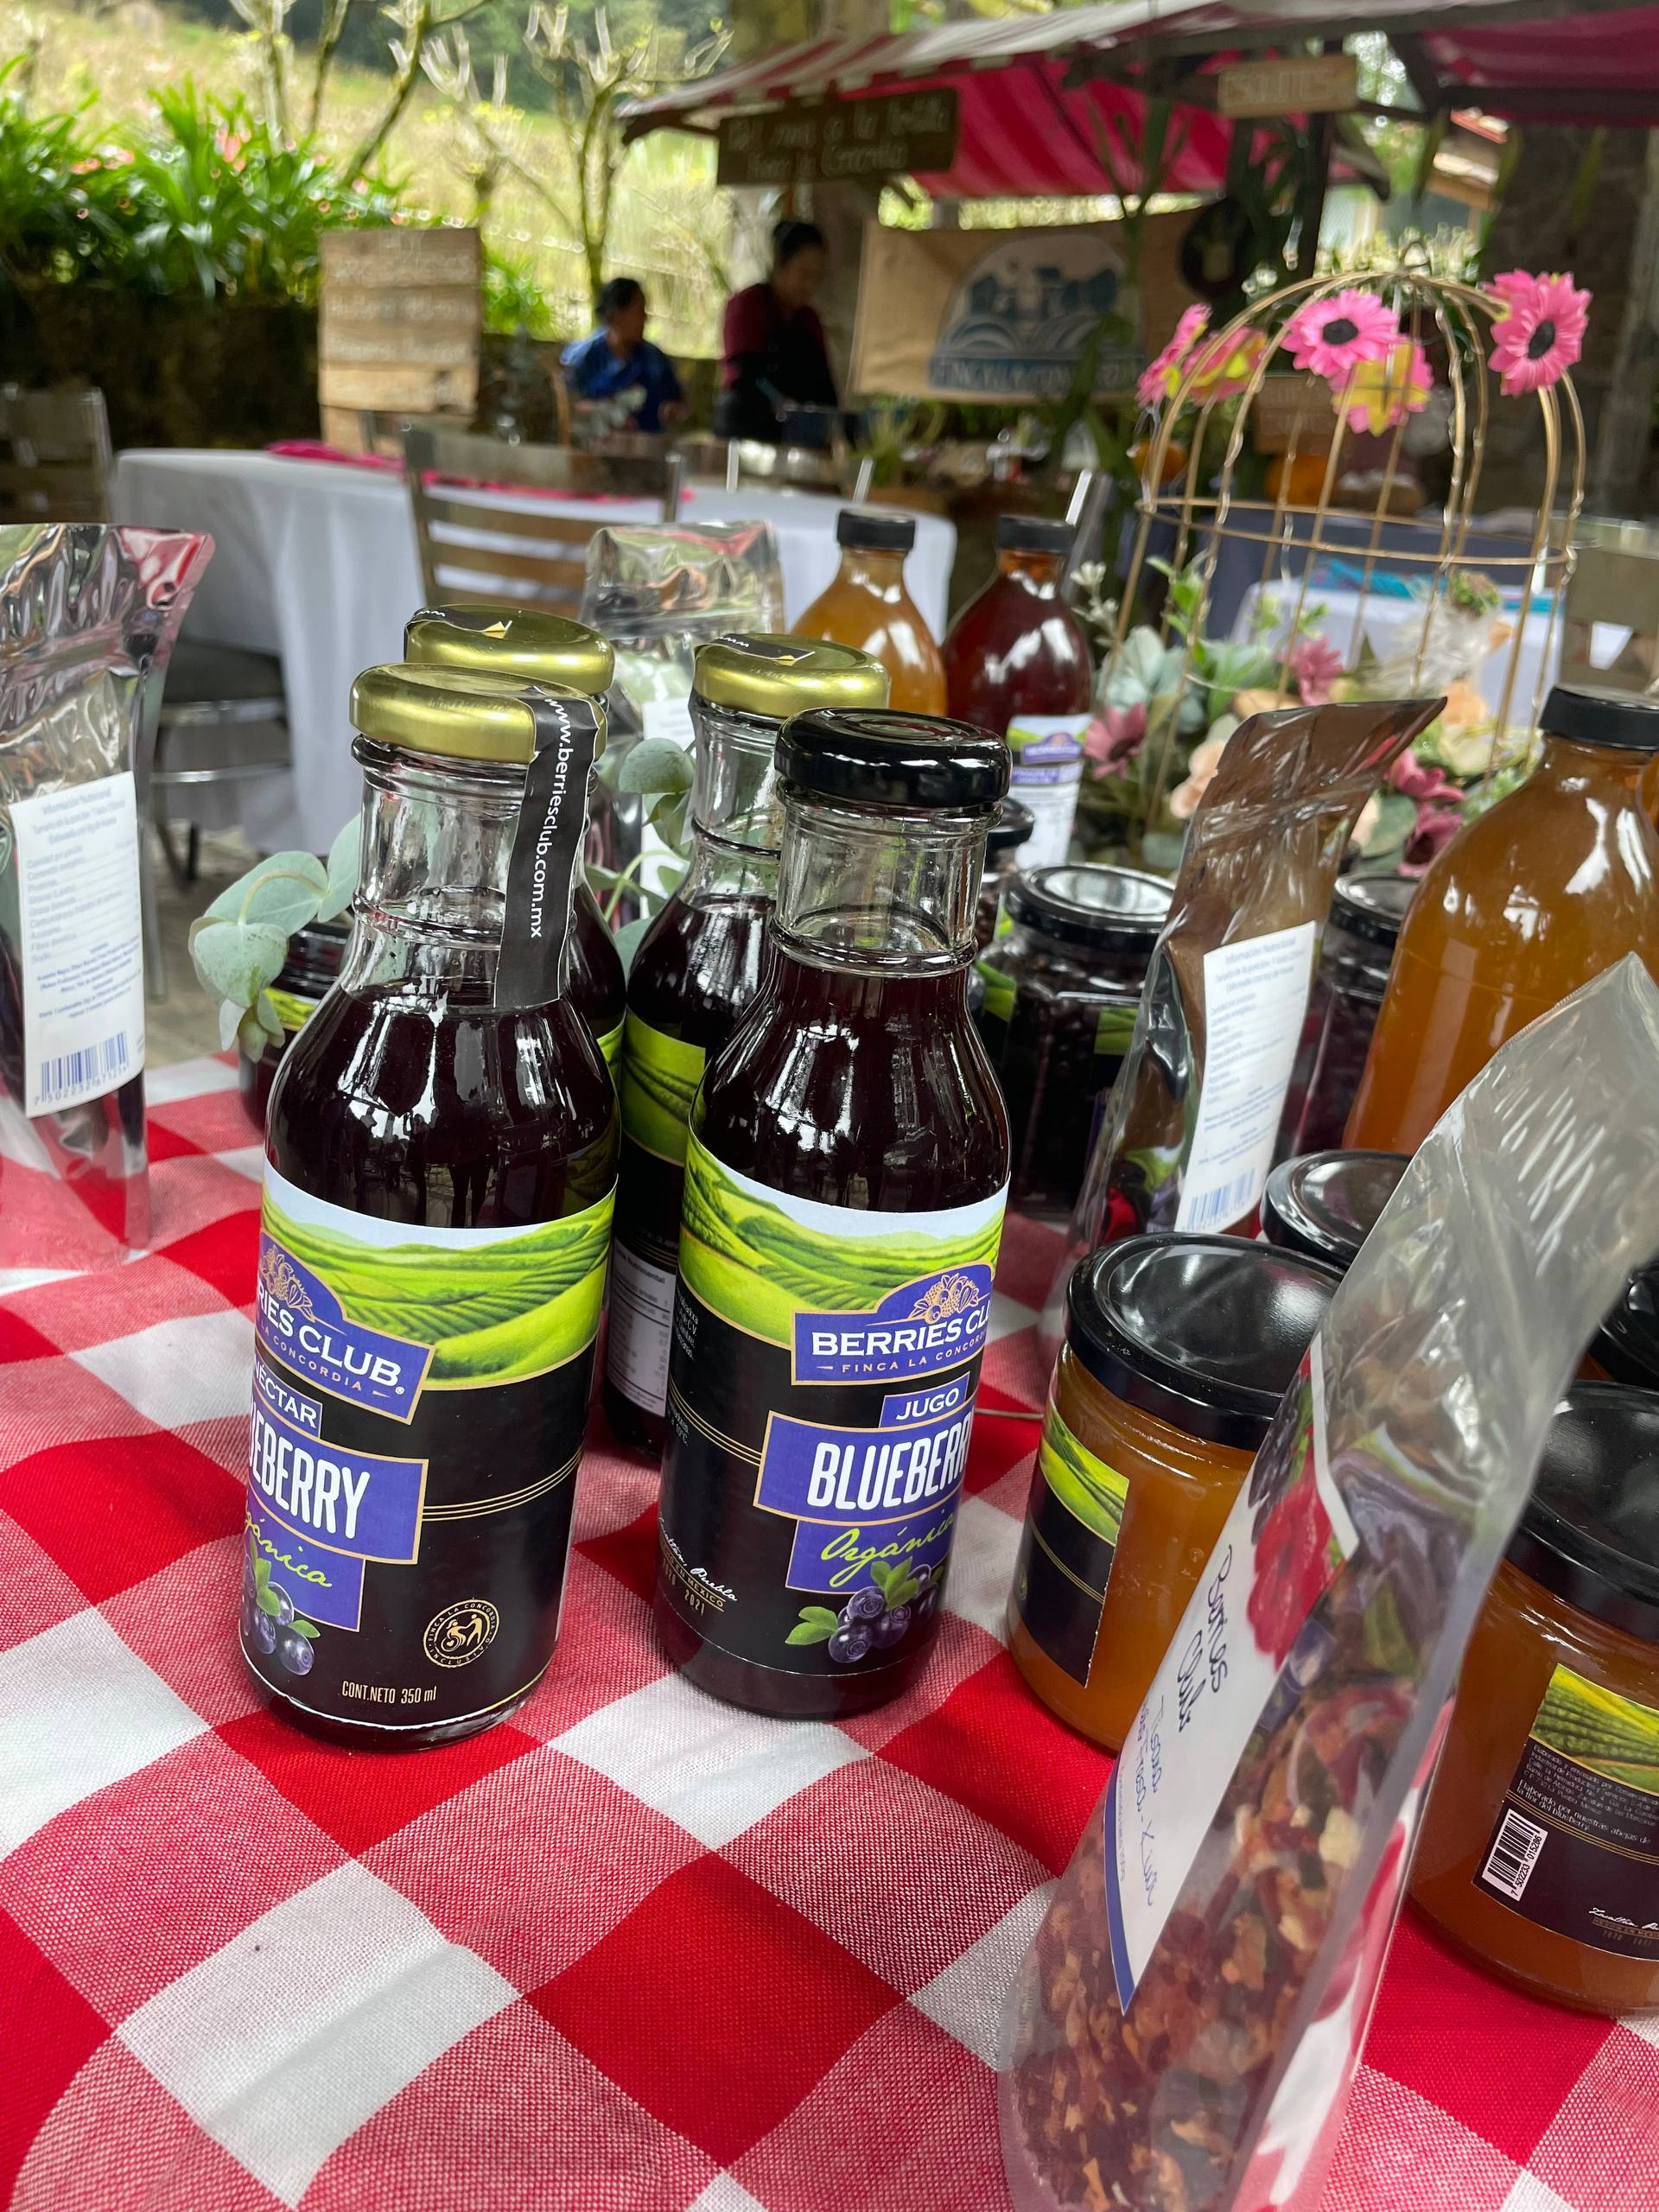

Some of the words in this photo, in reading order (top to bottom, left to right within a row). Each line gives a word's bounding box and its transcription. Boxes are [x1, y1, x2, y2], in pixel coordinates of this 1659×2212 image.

[531, 698, 575, 938] www.berriesclub.com.mx
[258, 1278, 295, 1338] RIES
[811, 1318, 963, 1357] BERRIES
[965, 1300, 990, 1335] CLU
[273, 1336, 362, 1391] CONCORDIA
[842, 1361, 899, 1373] FINCA
[908, 1356, 927, 1368] LA
[895, 1387, 960, 1421] JUGO
[250, 1398, 371, 1540] UEBERRY
[807, 1405, 975, 1510] BLUEBERR
[683, 1588, 706, 1616] 2021
[690, 1567, 738, 1601] Puebla
[429, 1617, 445, 1642] FINCA
[448, 1607, 460, 1616] LA
[464, 1603, 496, 1630] CONCORDIA
[400, 1688, 422, 1705] 350
[423, 1685, 437, 1702] ml
[1526, 1834, 1542, 1860] 015286
